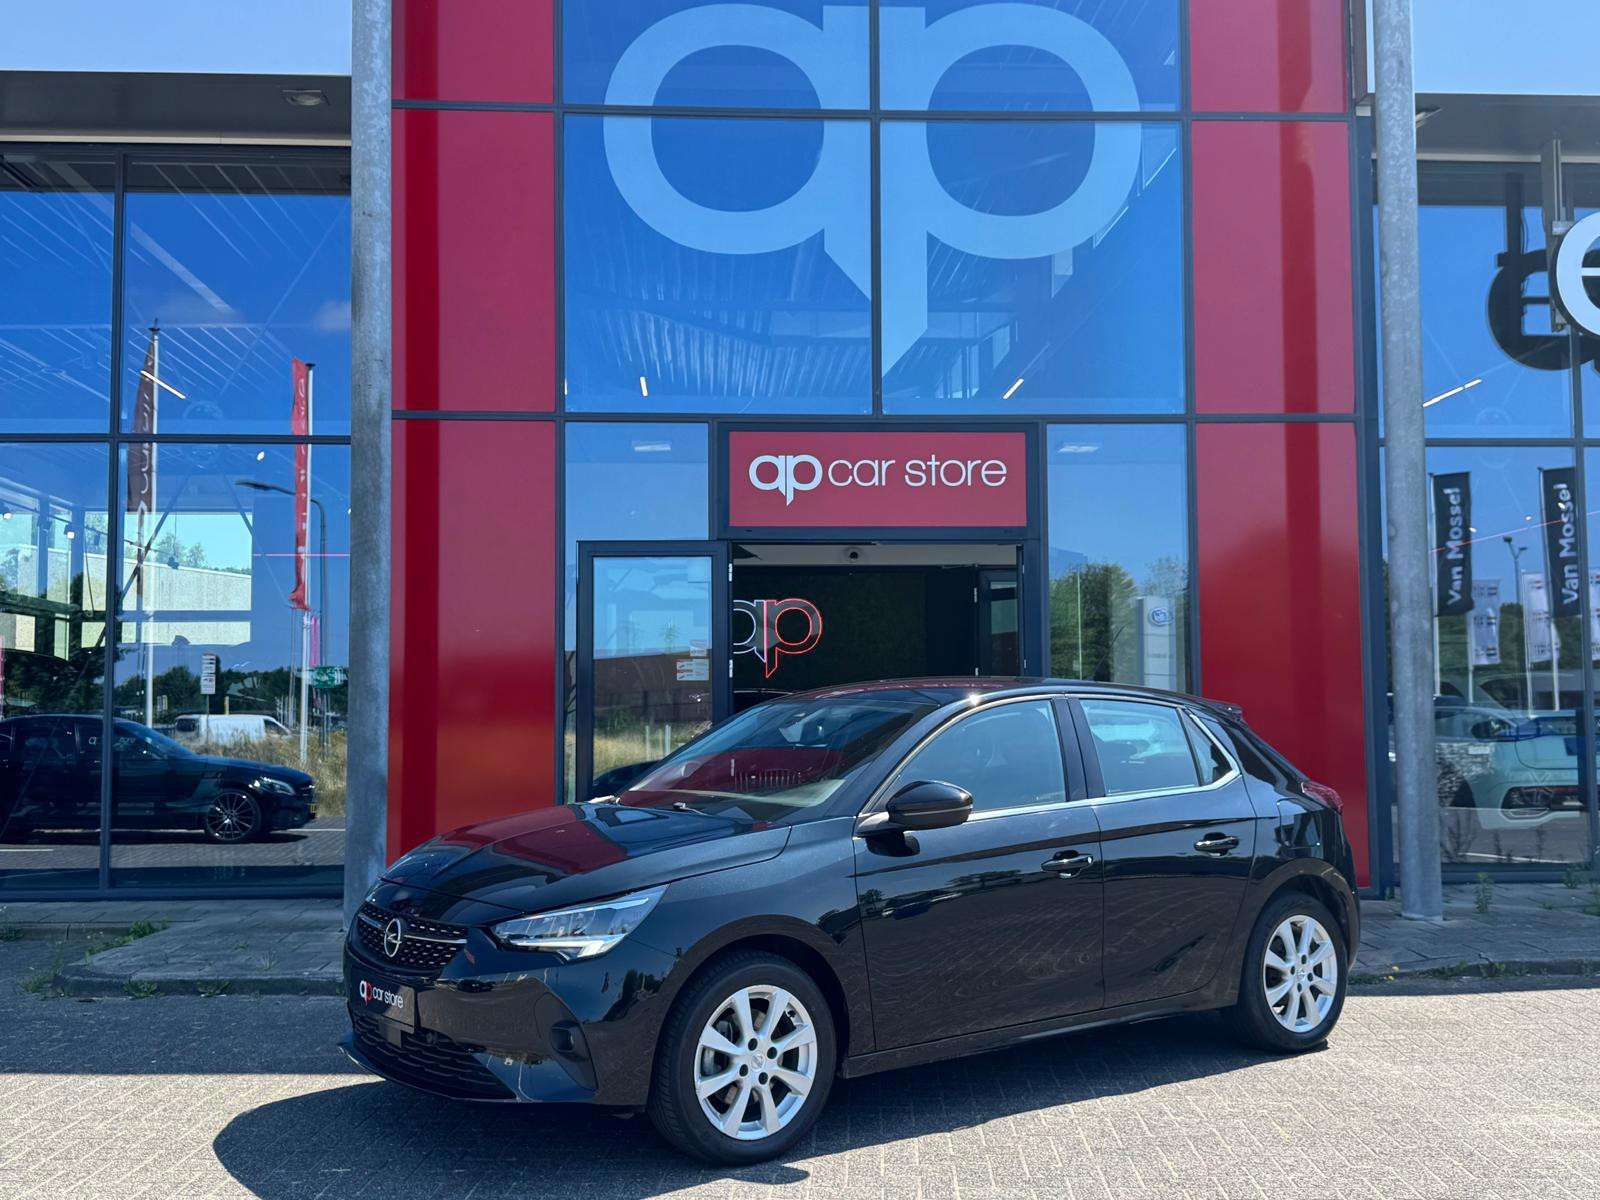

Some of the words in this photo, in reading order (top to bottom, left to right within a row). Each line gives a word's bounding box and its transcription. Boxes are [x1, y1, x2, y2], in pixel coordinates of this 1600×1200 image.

[602, 3, 1141, 379] ap
[749, 455, 823, 506] ap
[828, 459, 896, 487] car
[905, 454, 1007, 487] store
[1443, 487, 1464, 559] Mossel
[1553, 483, 1577, 558] Mossel
[1447, 564, 1463, 604] Van
[1561, 564, 1580, 605] Van
[373, 987, 384, 1001] car
[384, 990, 403, 1008] store
